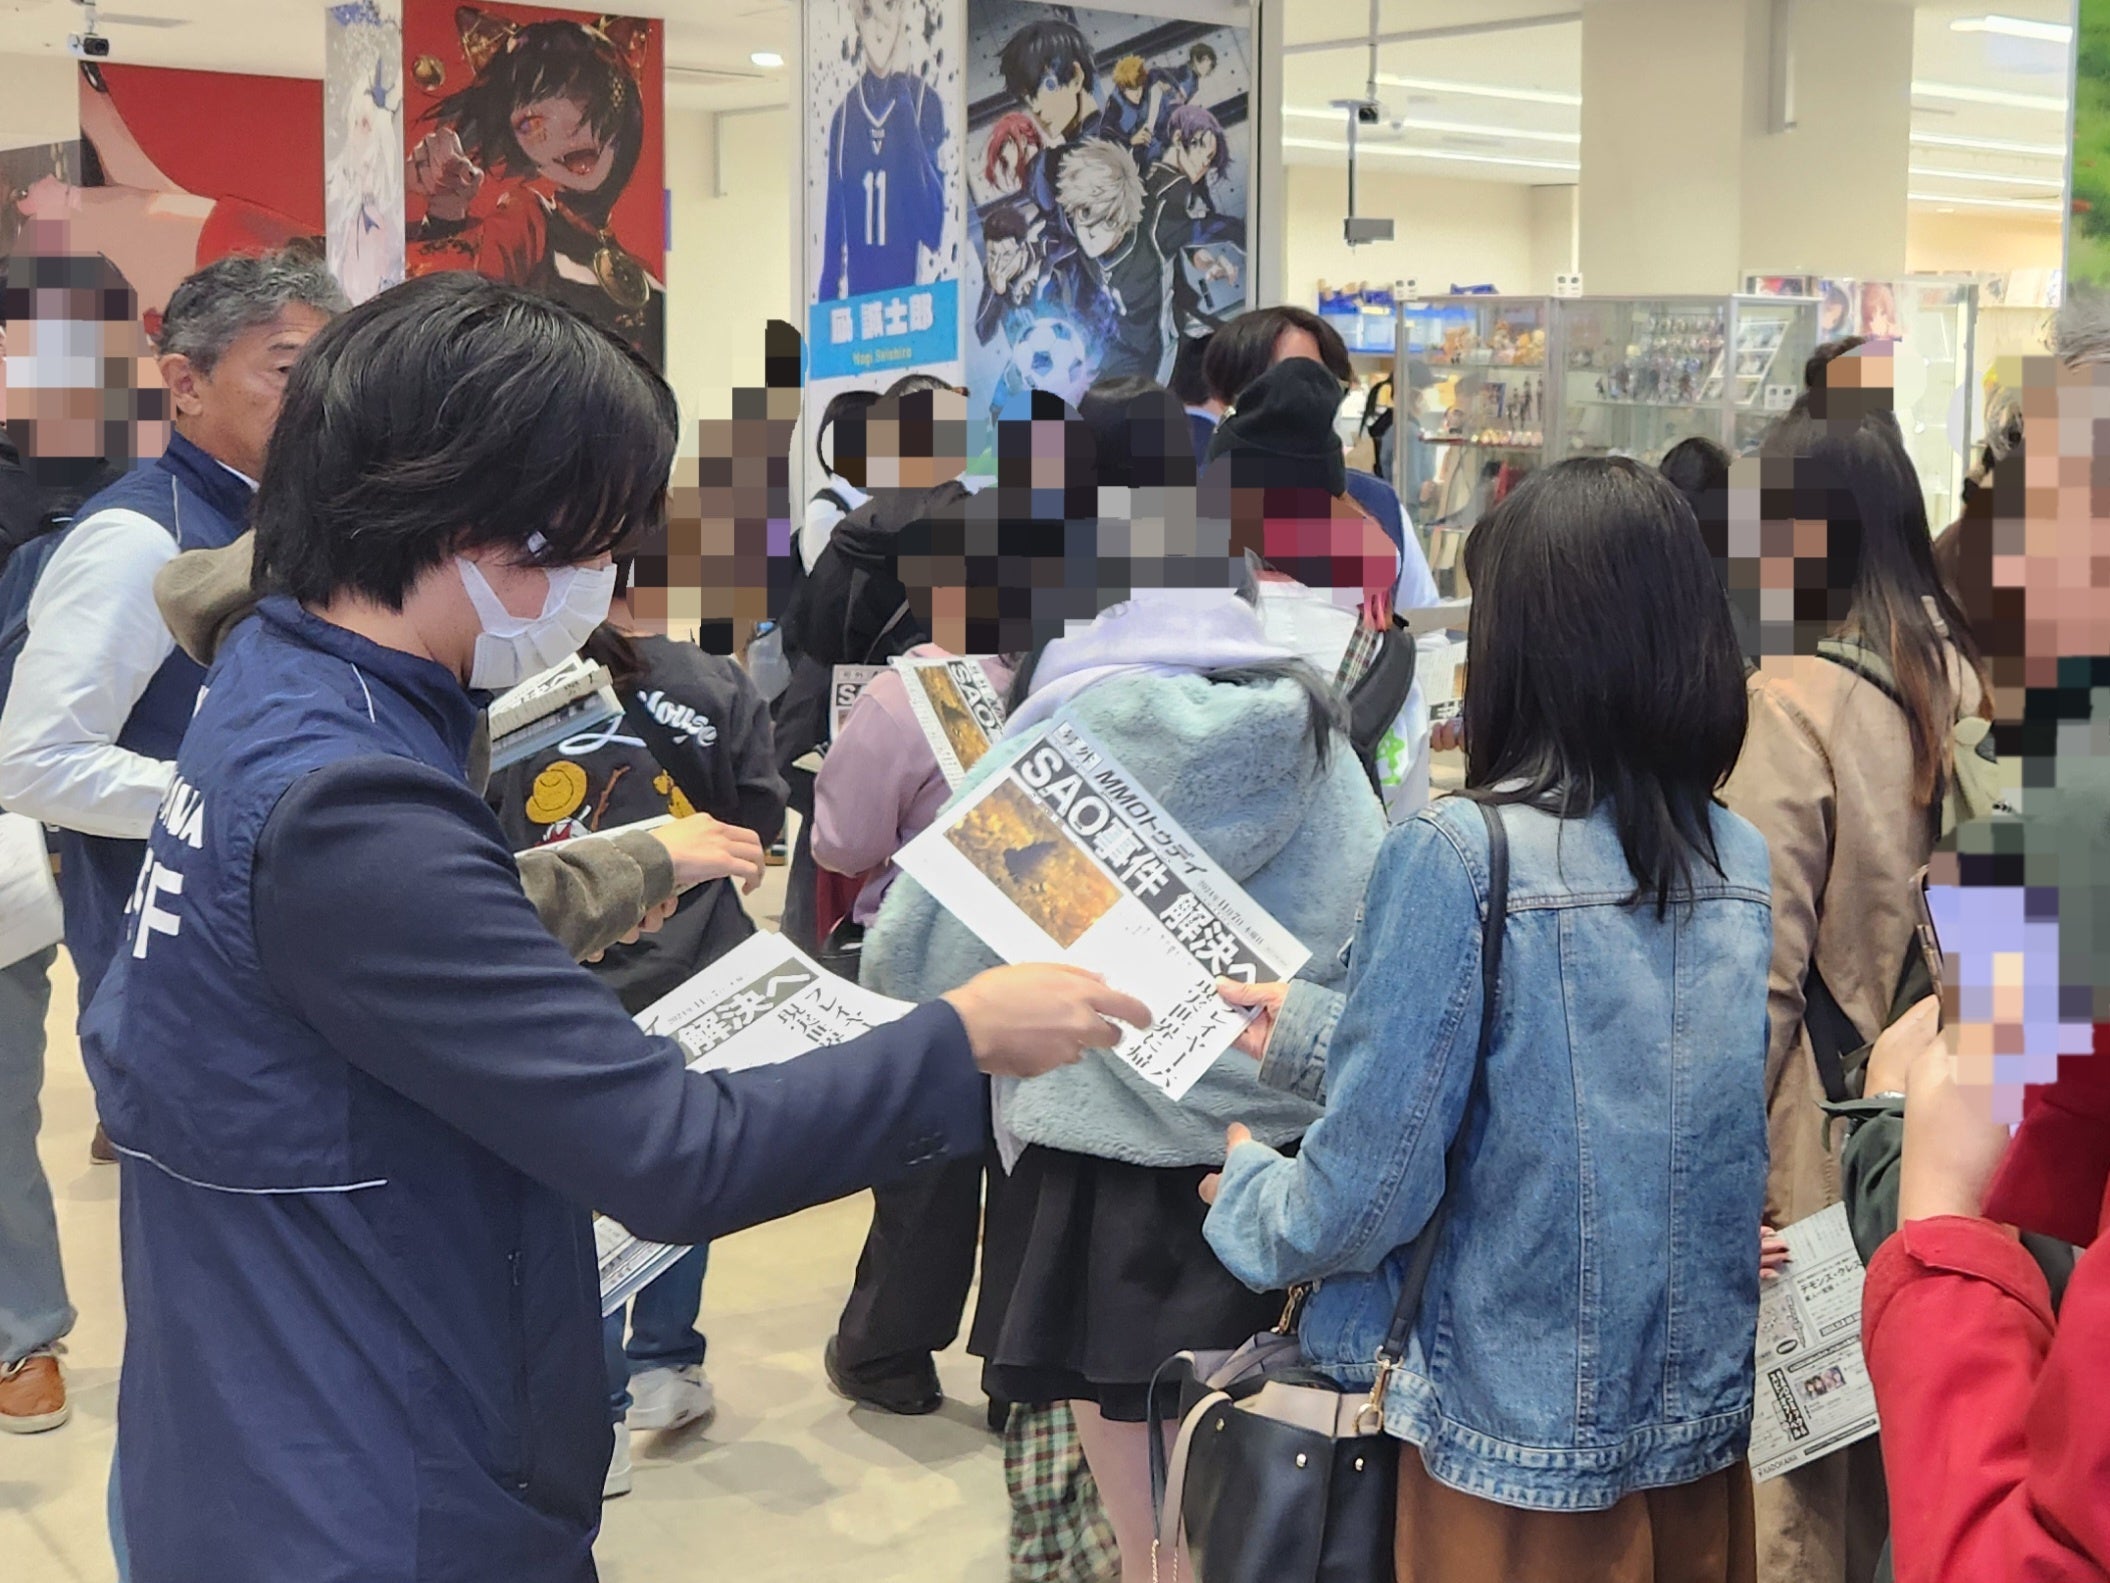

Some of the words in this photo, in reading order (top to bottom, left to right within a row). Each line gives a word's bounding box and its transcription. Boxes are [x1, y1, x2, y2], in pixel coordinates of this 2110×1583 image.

[863, 169, 887, 247] 11
[1020, 747, 1170, 898] SAO事件
[677, 973, 811, 1057] 解決へ
